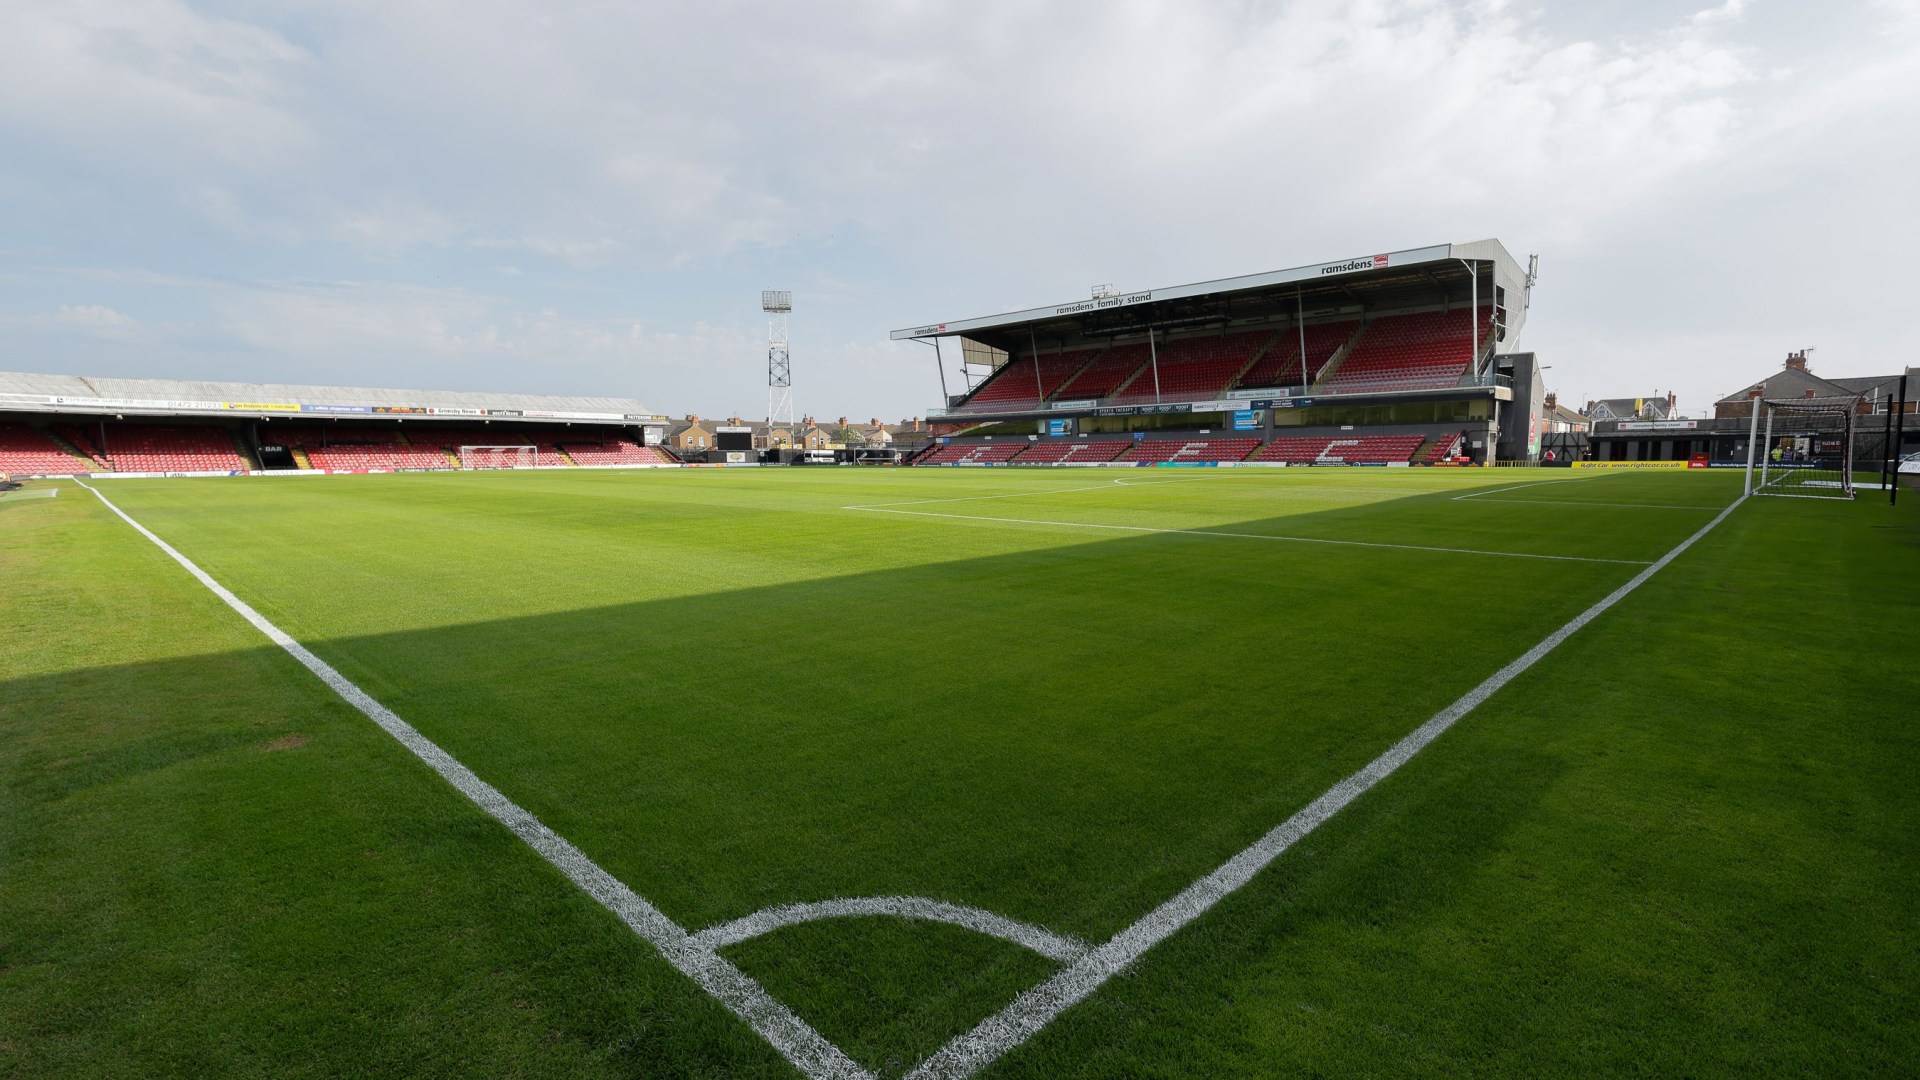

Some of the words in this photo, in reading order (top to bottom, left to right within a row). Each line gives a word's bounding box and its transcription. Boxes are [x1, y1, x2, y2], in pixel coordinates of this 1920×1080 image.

[1321, 260, 1372, 274] ramsdens
[1056, 303, 1094, 315] ramsdens
[1097, 297, 1123, 308] family
[1127, 292, 1152, 304] stand
[914, 326, 939, 336] ramsdens
